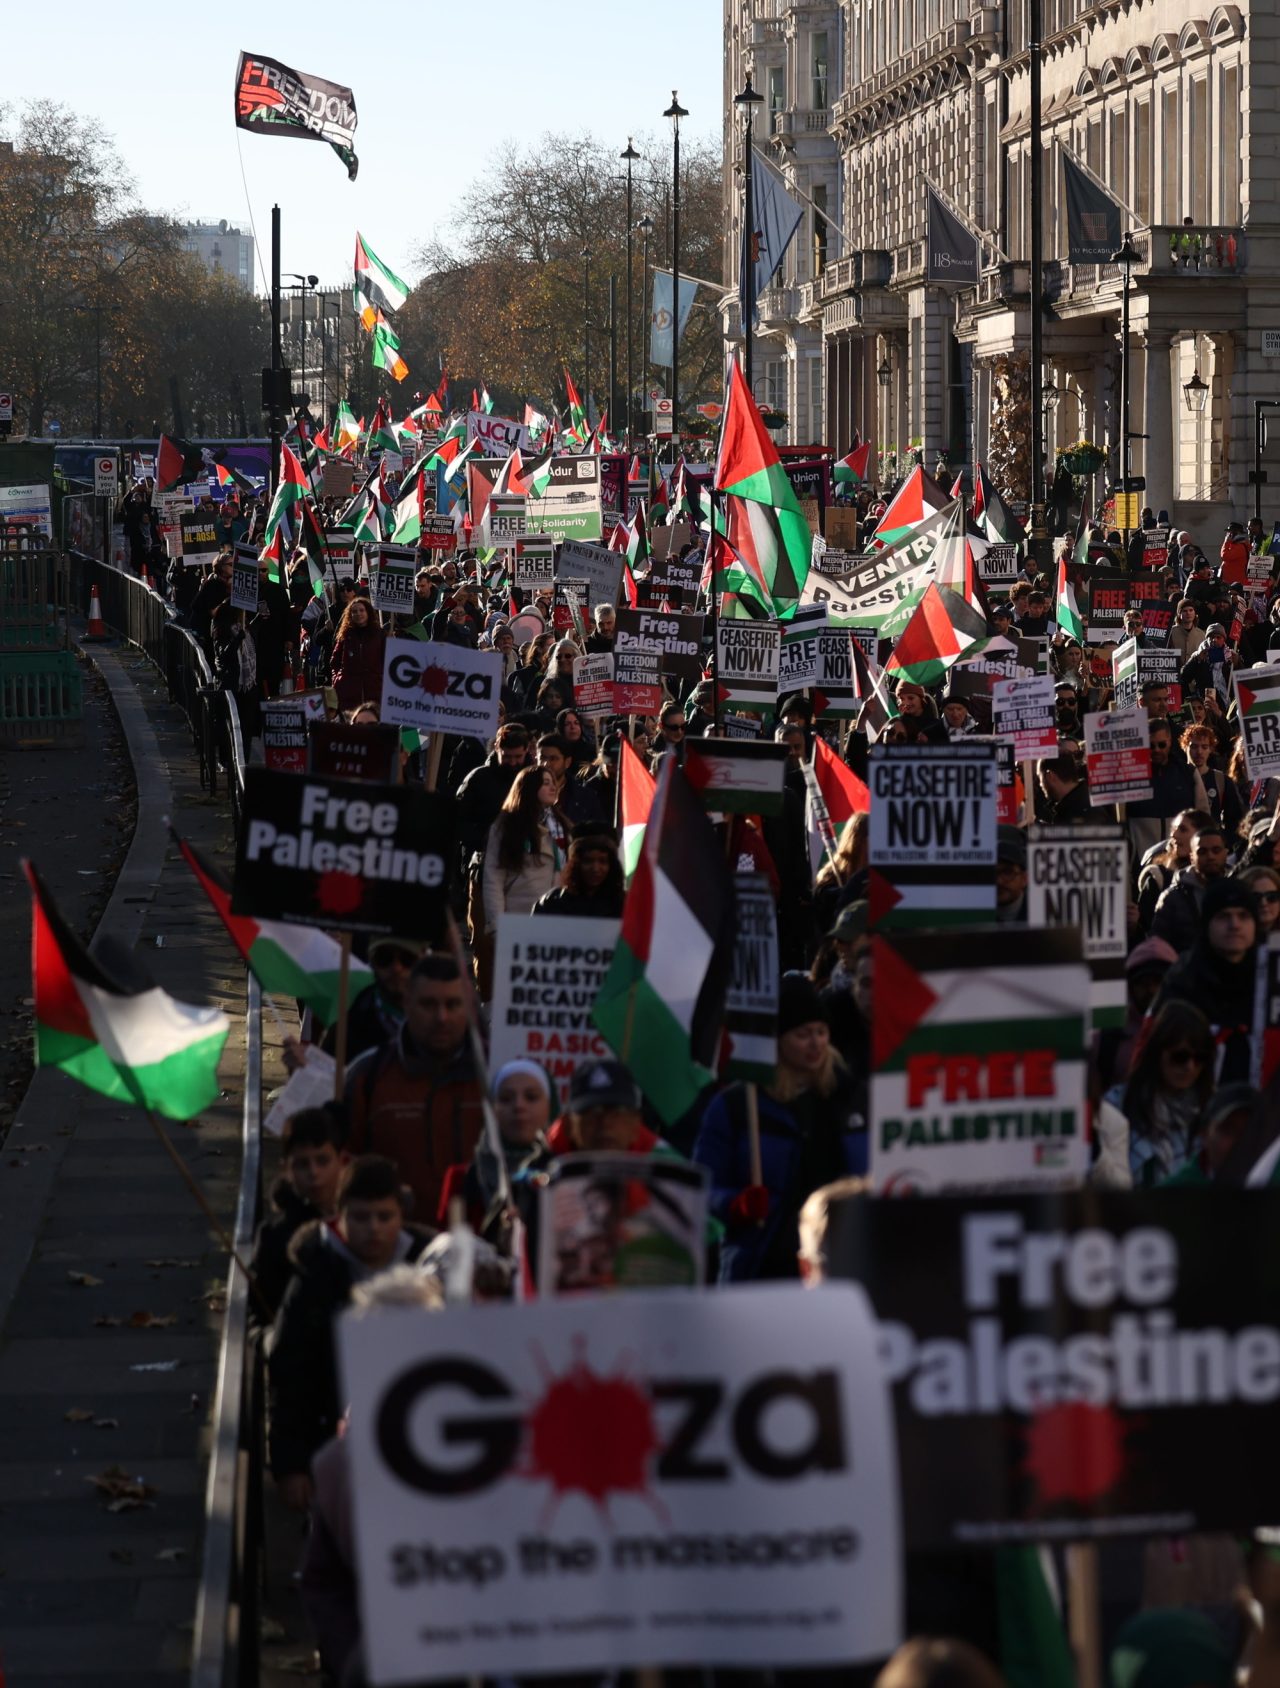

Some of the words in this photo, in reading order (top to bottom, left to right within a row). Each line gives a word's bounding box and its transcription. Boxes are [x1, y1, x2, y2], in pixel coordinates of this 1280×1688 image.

[934, 252, 951, 268] 118
[793, 472, 820, 483] Union
[490, 517, 525, 530] FREE
[542, 517, 587, 528] Solidarity
[517, 558, 552, 571] FREE
[837, 522, 945, 592] VENTRY
[984, 560, 1013, 574] NOW!
[233, 571, 258, 590] FREE
[666, 565, 694, 578] Free
[232, 588, 258, 600] PALESTINE
[378, 576, 415, 592] FREE
[377, 589, 413, 601] PALESTINE
[650, 592, 670, 601] GAZA
[1092, 590, 1127, 609] FREE
[1092, 608, 1126, 618] PALESTINE
[639, 614, 680, 635] Free
[616, 631, 698, 655] Palestine
[720, 628, 778, 650] CEASEFIRE
[618, 654, 658, 668] FREEDOM
[725, 647, 773, 673] NOW!
[780, 639, 817, 666] FRE
[1141, 657, 1177, 668] FREEDOM
[388, 654, 493, 701] Gza
[616, 670, 660, 685] PALESTINE
[779, 660, 817, 676] PALEST
[956, 658, 1035, 679] alestine
[1139, 672, 1179, 683] PALESTINE
[1115, 673, 1138, 701] FREE
[387, 695, 412, 709] Stop
[415, 700, 432, 711] the
[434, 705, 490, 720] massacre
[265, 712, 303, 727] FREEDOM
[329, 741, 368, 757] CEASE
[875, 764, 992, 798] CEASEFIRE
[299, 783, 399, 837] Free
[888, 800, 980, 847] NOW!
[246, 818, 446, 888] Palestine
[1033, 846, 1123, 886] CEASEFIRE
[1046, 888, 1115, 939] NOW!
[513, 944, 519, 960] I
[511, 965, 602, 986] PALESTI
[527, 1032, 606, 1057] BASIC
[905, 1049, 1057, 1111] FREE
[880, 1110, 1077, 1153] PALESTINE
[959, 1209, 1177, 1308] Free
[374, 1353, 852, 1499] Gza
[388, 1537, 505, 1590] Stop
[518, 1525, 594, 1575] the
[612, 1520, 861, 1570] massacre
